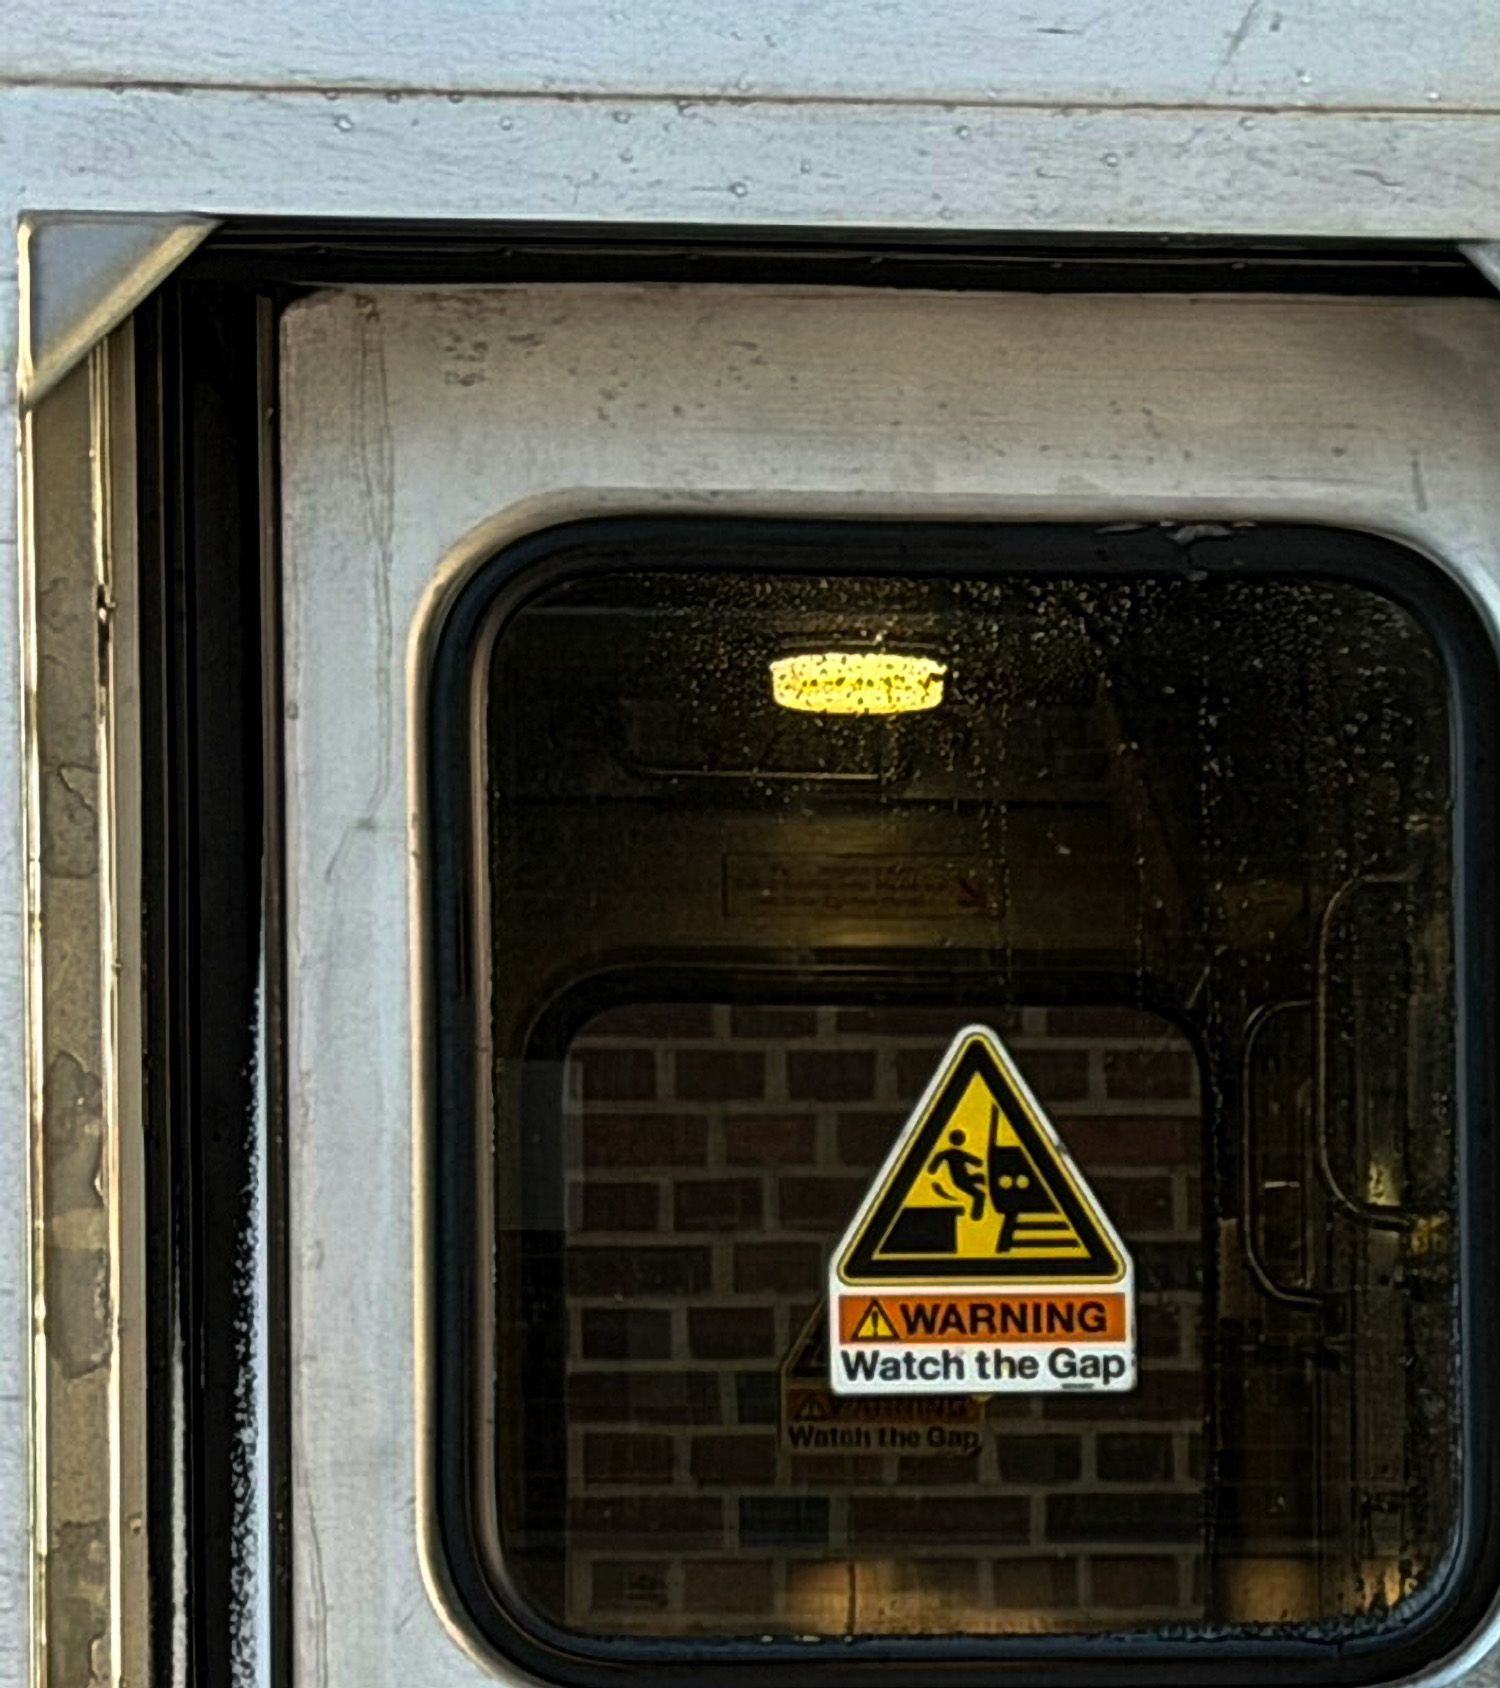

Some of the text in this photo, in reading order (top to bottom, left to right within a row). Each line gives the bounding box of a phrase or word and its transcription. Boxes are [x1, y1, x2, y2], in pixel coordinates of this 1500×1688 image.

[900, 1303, 1107, 1335] WARNING
[840, 1349, 1126, 1385] Watch the Gap
[788, 1425, 981, 1450] Watch the Gap
